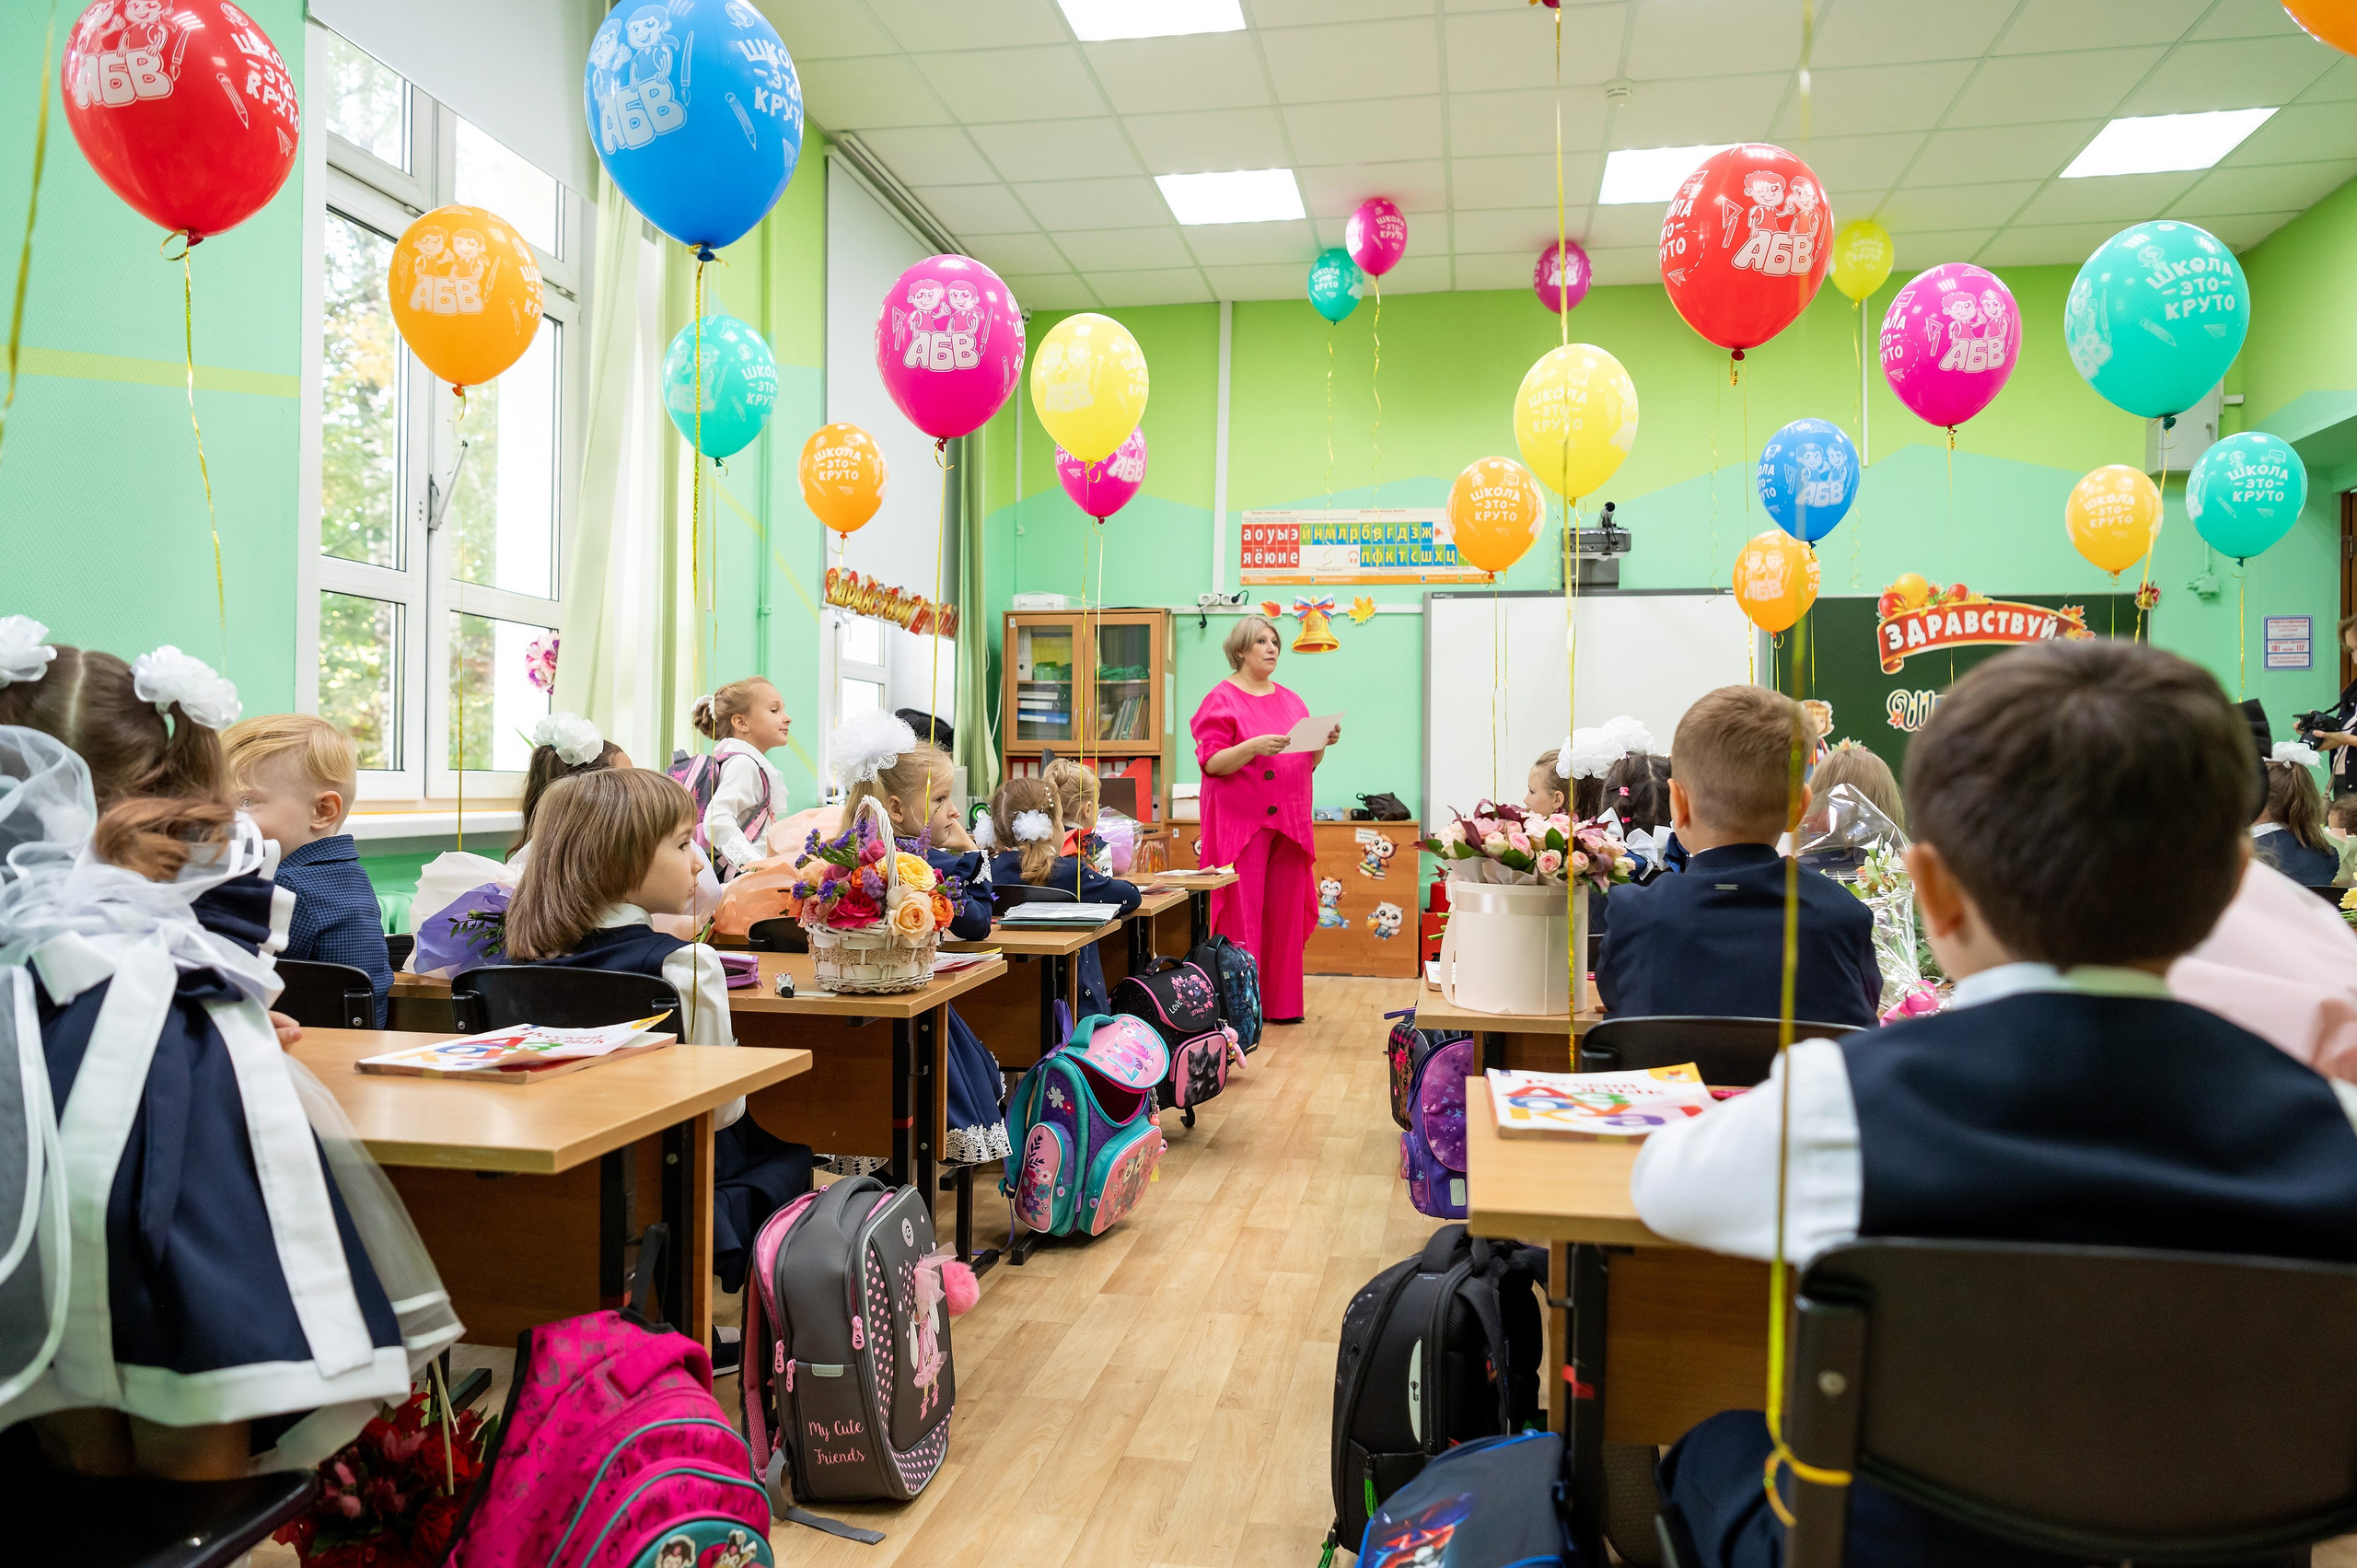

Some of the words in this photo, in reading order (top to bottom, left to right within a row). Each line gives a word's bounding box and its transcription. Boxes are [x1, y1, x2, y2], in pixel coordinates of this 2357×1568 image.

[75, 49, 173, 110] АБВ
[246, 74, 300, 134] КРУТО
[601, 78, 687, 155] АБВ
[1376, 215, 1405, 227] ШКОЛА
[1380, 230, 1403, 240] КРУТО
[1732, 230, 1814, 276] АБВ
[1311, 267, 1340, 280] ШКОЛА
[1548, 270, 1578, 287] АВ
[2145, 257, 2234, 289] ШКОЛА
[410, 275, 484, 316] АБВ
[1315, 281, 1339, 291] КРУТО
[2165, 295, 2235, 320] КРУТО
[904, 331, 980, 372] АБВ
[1939, 337, 2005, 373] АБВ
[2071, 330, 2113, 380] БВ
[741, 365, 778, 383] ШКОЛ
[669, 384, 716, 413] АБВ
[1045, 384, 1094, 412] АБВ
[1528, 388, 1587, 408] ШКОЛА
[1533, 418, 1583, 433] КРУТО
[814, 447, 861, 462] ШКОЛА
[819, 470, 859, 481] КРУТО
[1107, 456, 1144, 482] АБВ
[2227, 464, 2289, 482] ШКОЛА
[1470, 487, 1520, 502] ШКОЛА
[1794, 481, 1844, 507] АБВ
[2084, 494, 2135, 511] ШКОЛА
[2232, 490, 2284, 503] КРУТО
[1475, 510, 1517, 522] КРУТО
[2090, 515, 2133, 528] КРУТО
[1744, 579, 1784, 601] АБВ
[826, 575, 915, 631] ЗДРАВСТВУЙ
[1885, 610, 2059, 650] ЗДРАВСТВУЙ
[1168, 998, 1183, 1014] LOVE
[808, 1422, 830, 1442] My
[834, 1419, 864, 1435] Cute
[814, 1447, 865, 1465] Friends
